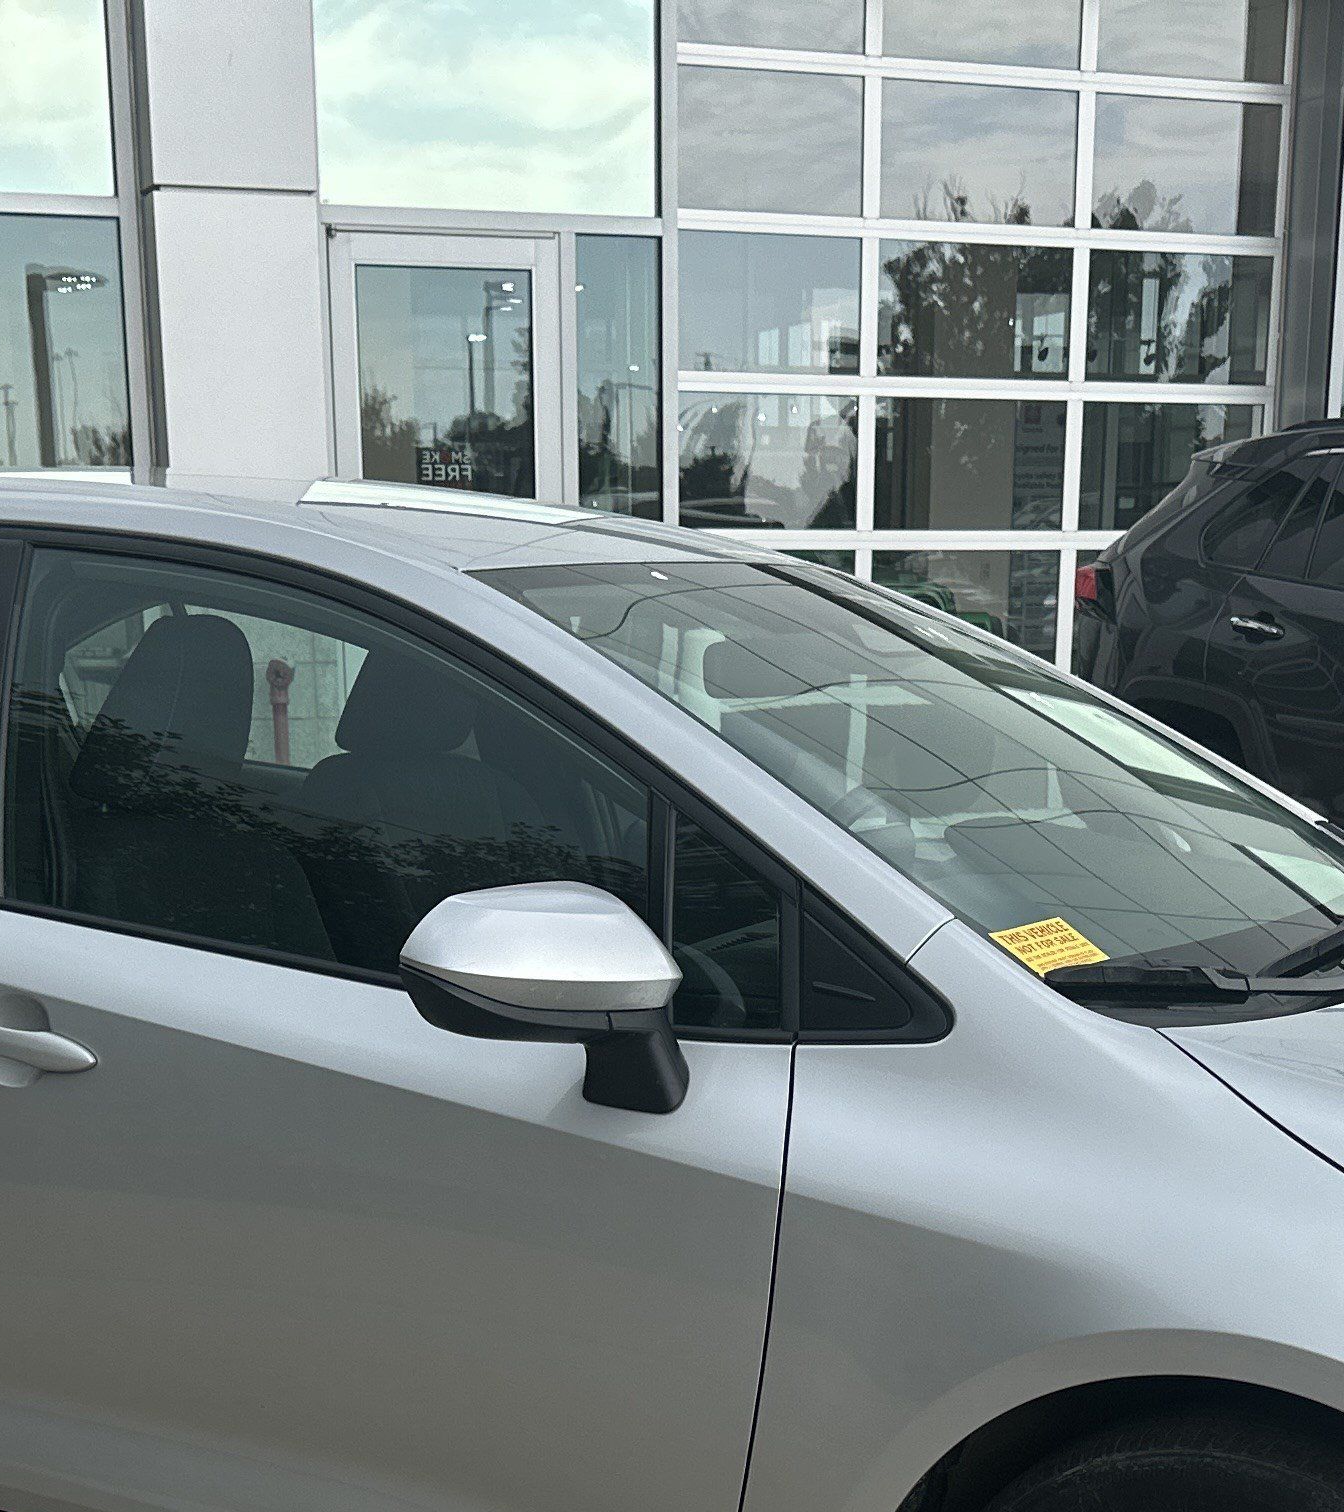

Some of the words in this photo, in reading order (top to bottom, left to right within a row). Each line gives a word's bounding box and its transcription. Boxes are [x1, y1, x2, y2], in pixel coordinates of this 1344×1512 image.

[997, 930, 1029, 946] THIS
[1024, 921, 1069, 939] VEHICLE
[1016, 943, 1036, 955] NOT
[1036, 939, 1054, 950] FOR
[1055, 932, 1079, 945] SALE
